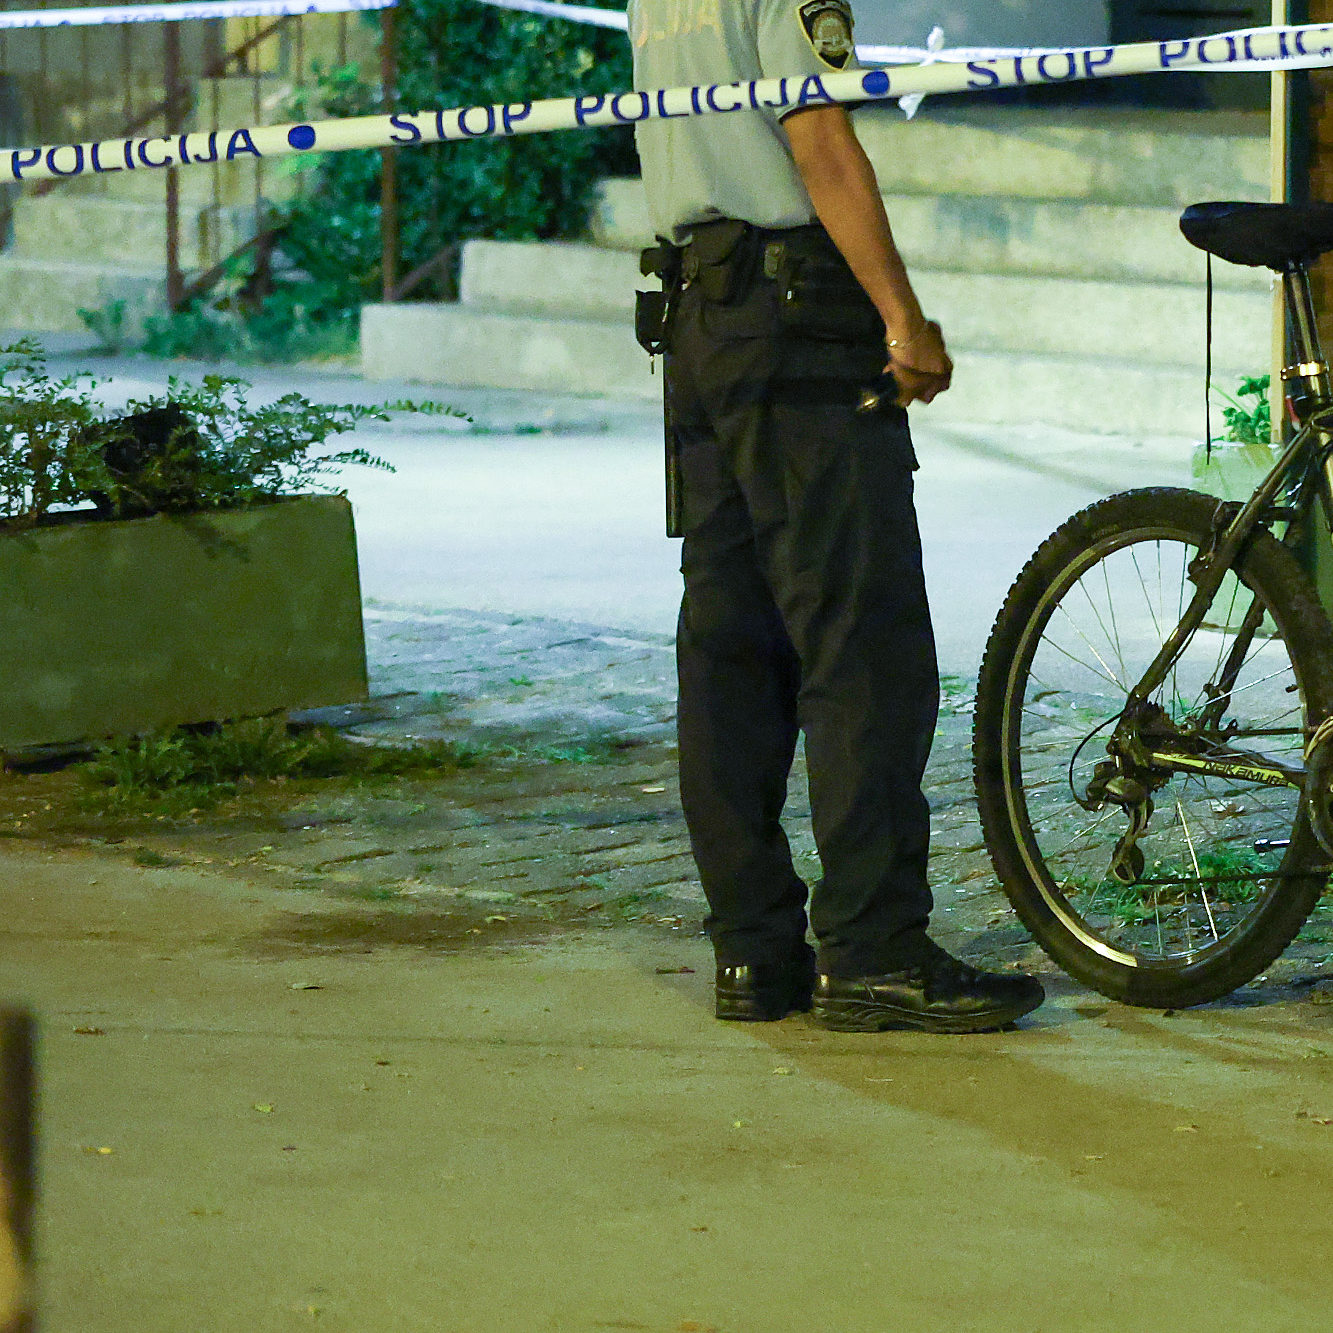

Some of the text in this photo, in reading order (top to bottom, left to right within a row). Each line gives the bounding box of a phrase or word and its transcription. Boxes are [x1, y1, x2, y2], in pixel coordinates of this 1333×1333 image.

[11, 128, 262, 179] POLICIJA
[389, 100, 533, 143] STOP
[575, 73, 834, 127] POLICIJA
[966, 47, 1114, 90] STOP
